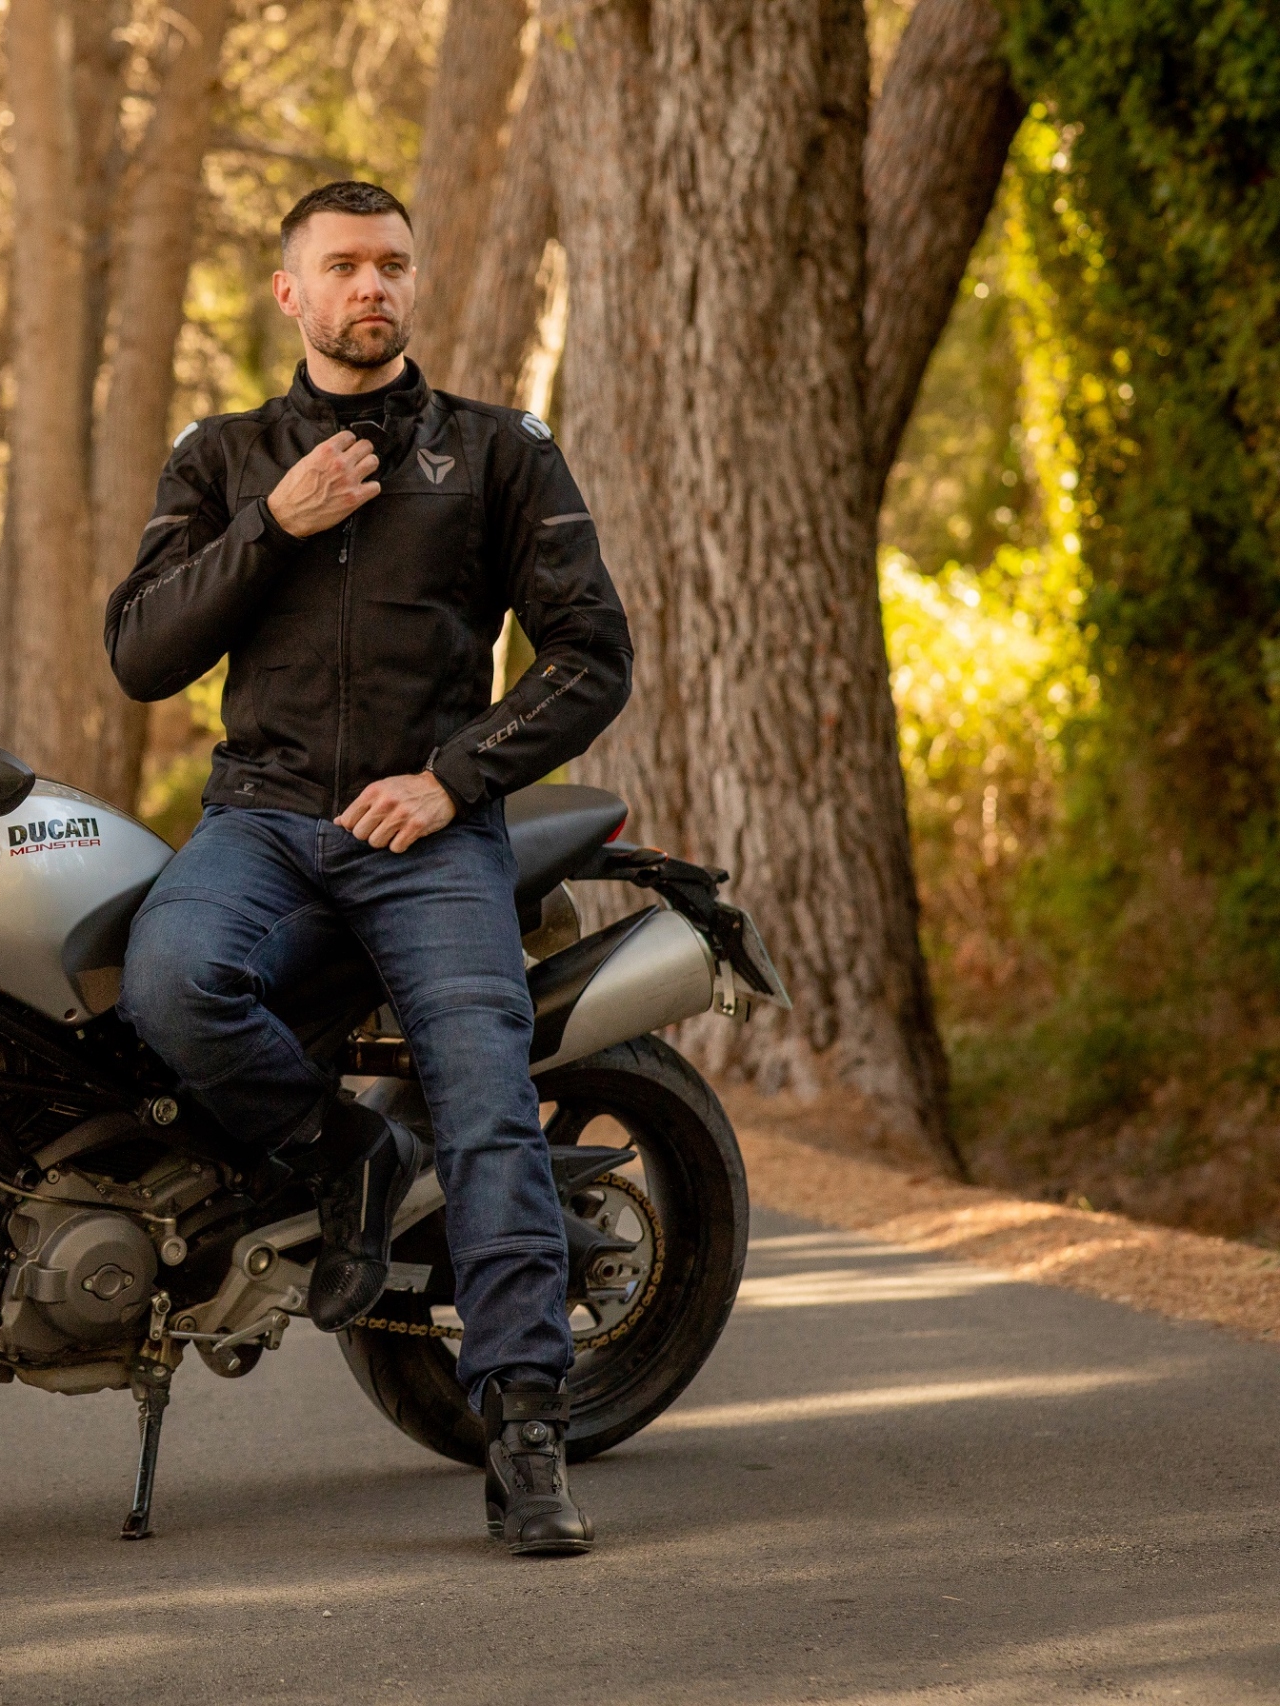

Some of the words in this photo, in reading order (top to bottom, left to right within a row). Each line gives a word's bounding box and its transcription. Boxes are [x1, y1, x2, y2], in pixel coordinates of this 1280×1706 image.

[477, 720, 519, 754] SECA
[525, 693, 555, 721] SAFETY
[555, 667, 589, 696] CONCEPT
[7, 818, 100, 847] DUCATI
[10, 838, 101, 857] MONSTER
